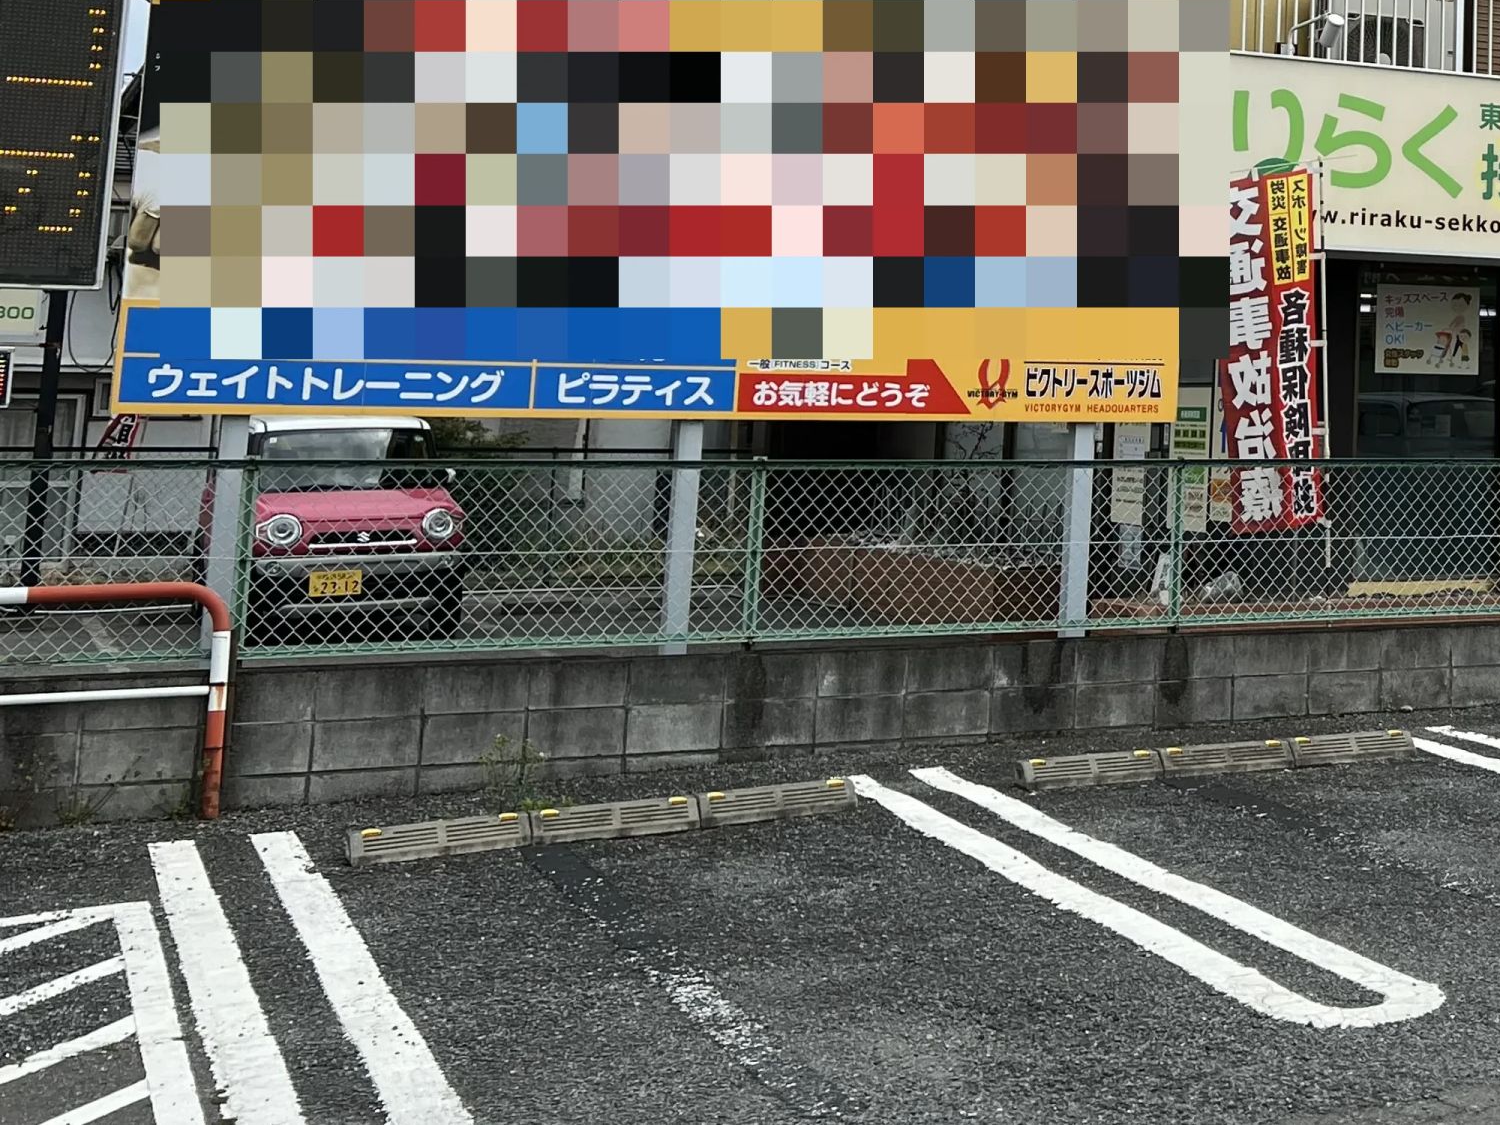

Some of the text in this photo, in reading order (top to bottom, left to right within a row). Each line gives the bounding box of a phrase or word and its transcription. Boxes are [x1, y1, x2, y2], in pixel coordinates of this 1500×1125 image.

[1232, 88, 1464, 200] りらく
[147, 363, 505, 404] ウェイトトレーニング
[556, 372, 715, 407] ピラティス
[752, 379, 931, 408] お気軽にどうぞ
[1025, 367, 1162, 399] ビクトリースポーツジム
[1024, 403, 1160, 414] VICTORYGYM HEADQUARTERS
